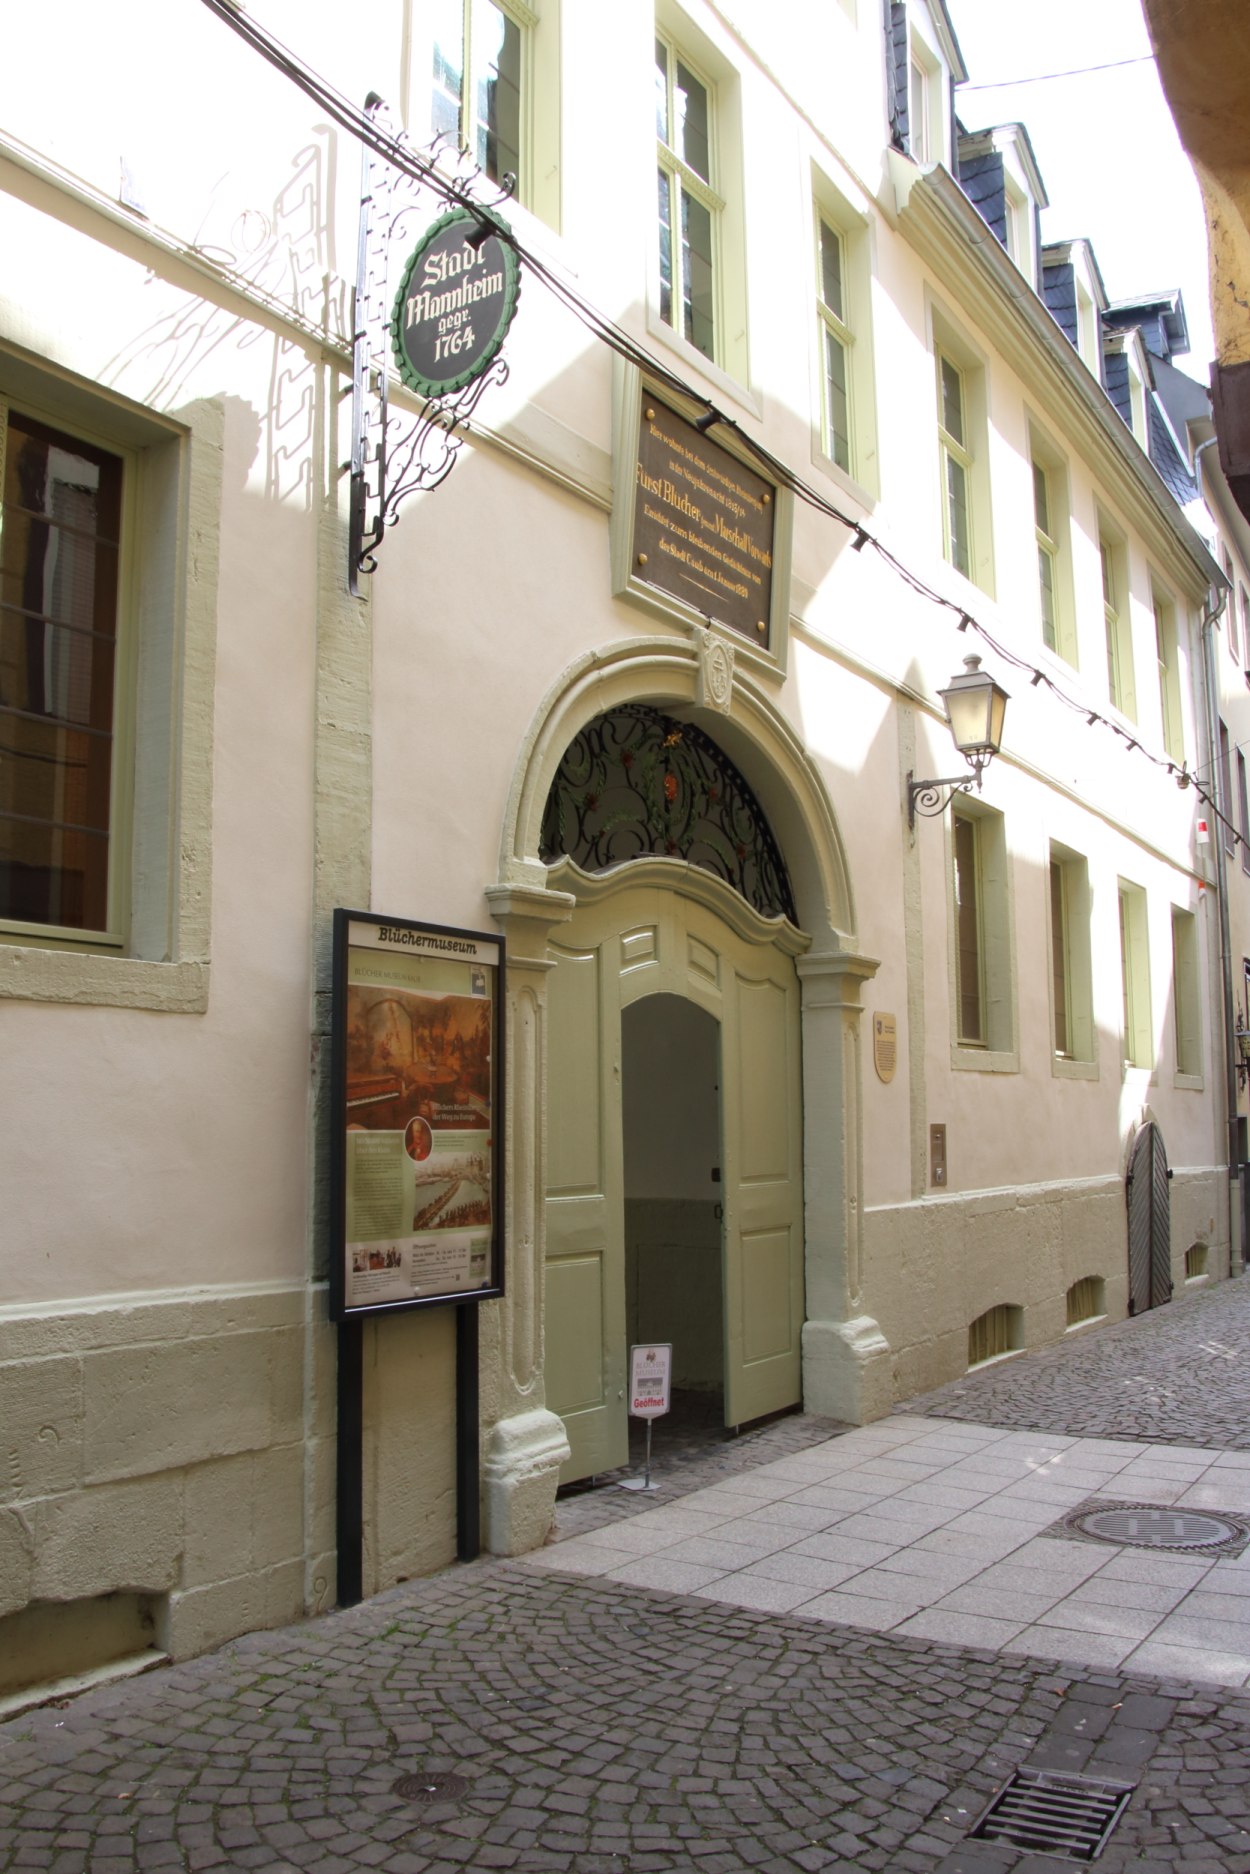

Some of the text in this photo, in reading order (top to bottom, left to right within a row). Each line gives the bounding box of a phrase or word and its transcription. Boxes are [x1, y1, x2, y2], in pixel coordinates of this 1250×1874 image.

[421, 241, 486, 289] Stadt
[406, 268, 503, 330] Mannheim
[438, 309, 471, 335] gegr.
[434, 326, 475, 363] 1764
[378, 927, 477, 955] Blüchermuseum
[634, 1397, 664, 1408] Geöffnet
